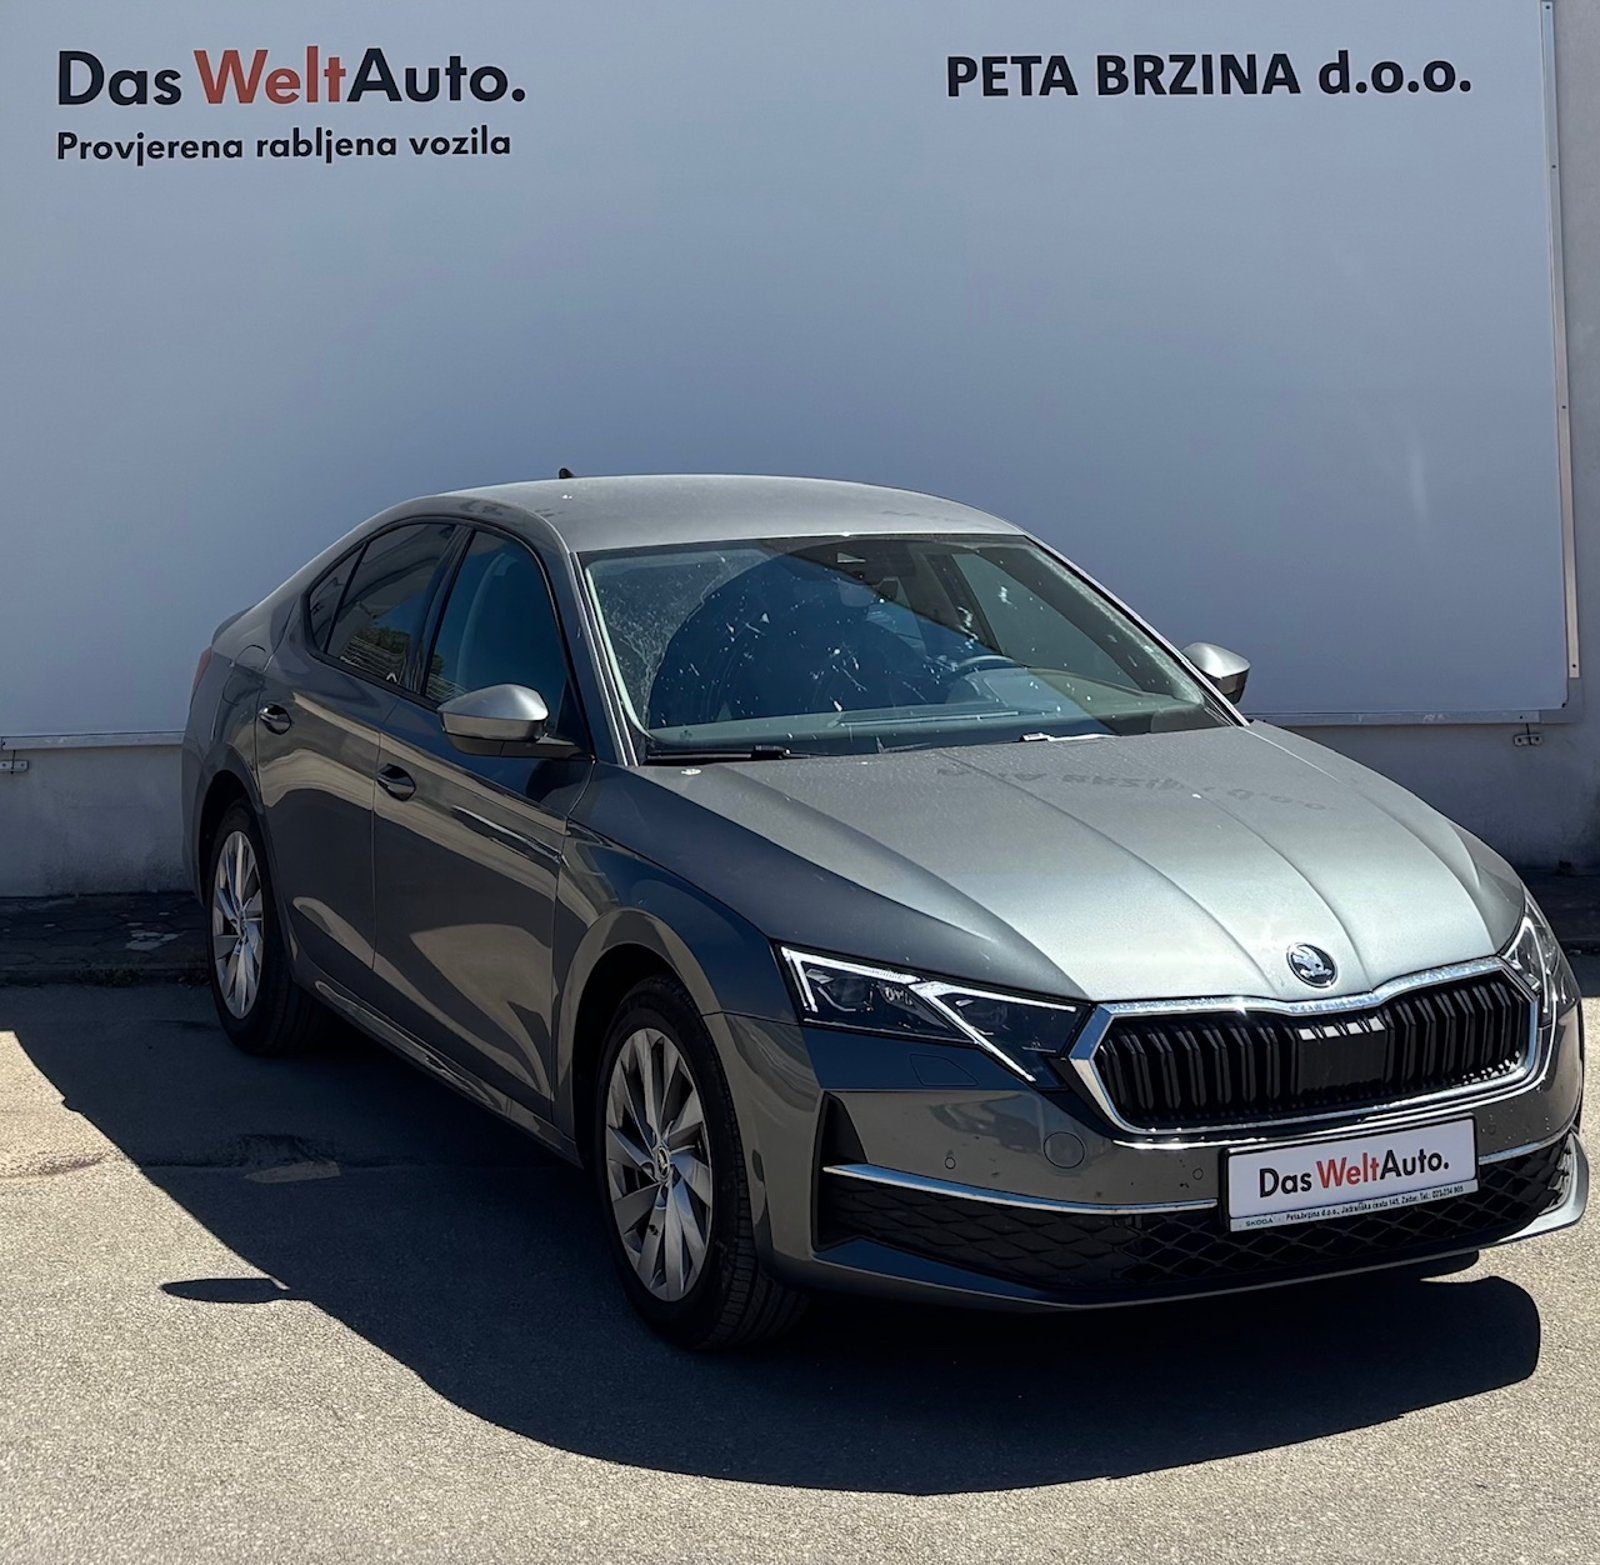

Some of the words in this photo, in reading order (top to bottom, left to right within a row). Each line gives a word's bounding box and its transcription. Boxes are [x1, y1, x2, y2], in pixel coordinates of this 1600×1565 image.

[58, 50, 182, 106] Das
[193, 45, 526, 105] WeltAuto.
[947, 55, 1078, 97] PETA
[1096, 53, 1302, 96] BRZINA
[1318, 49, 1472, 95] d.o.o.
[57, 131, 243, 167] Provjerena
[256, 126, 397, 164] rabljena
[408, 124, 511, 156] vozila
[1259, 1167, 1312, 1198] Das
[1316, 1148, 1449, 1189] WeltAuto.
